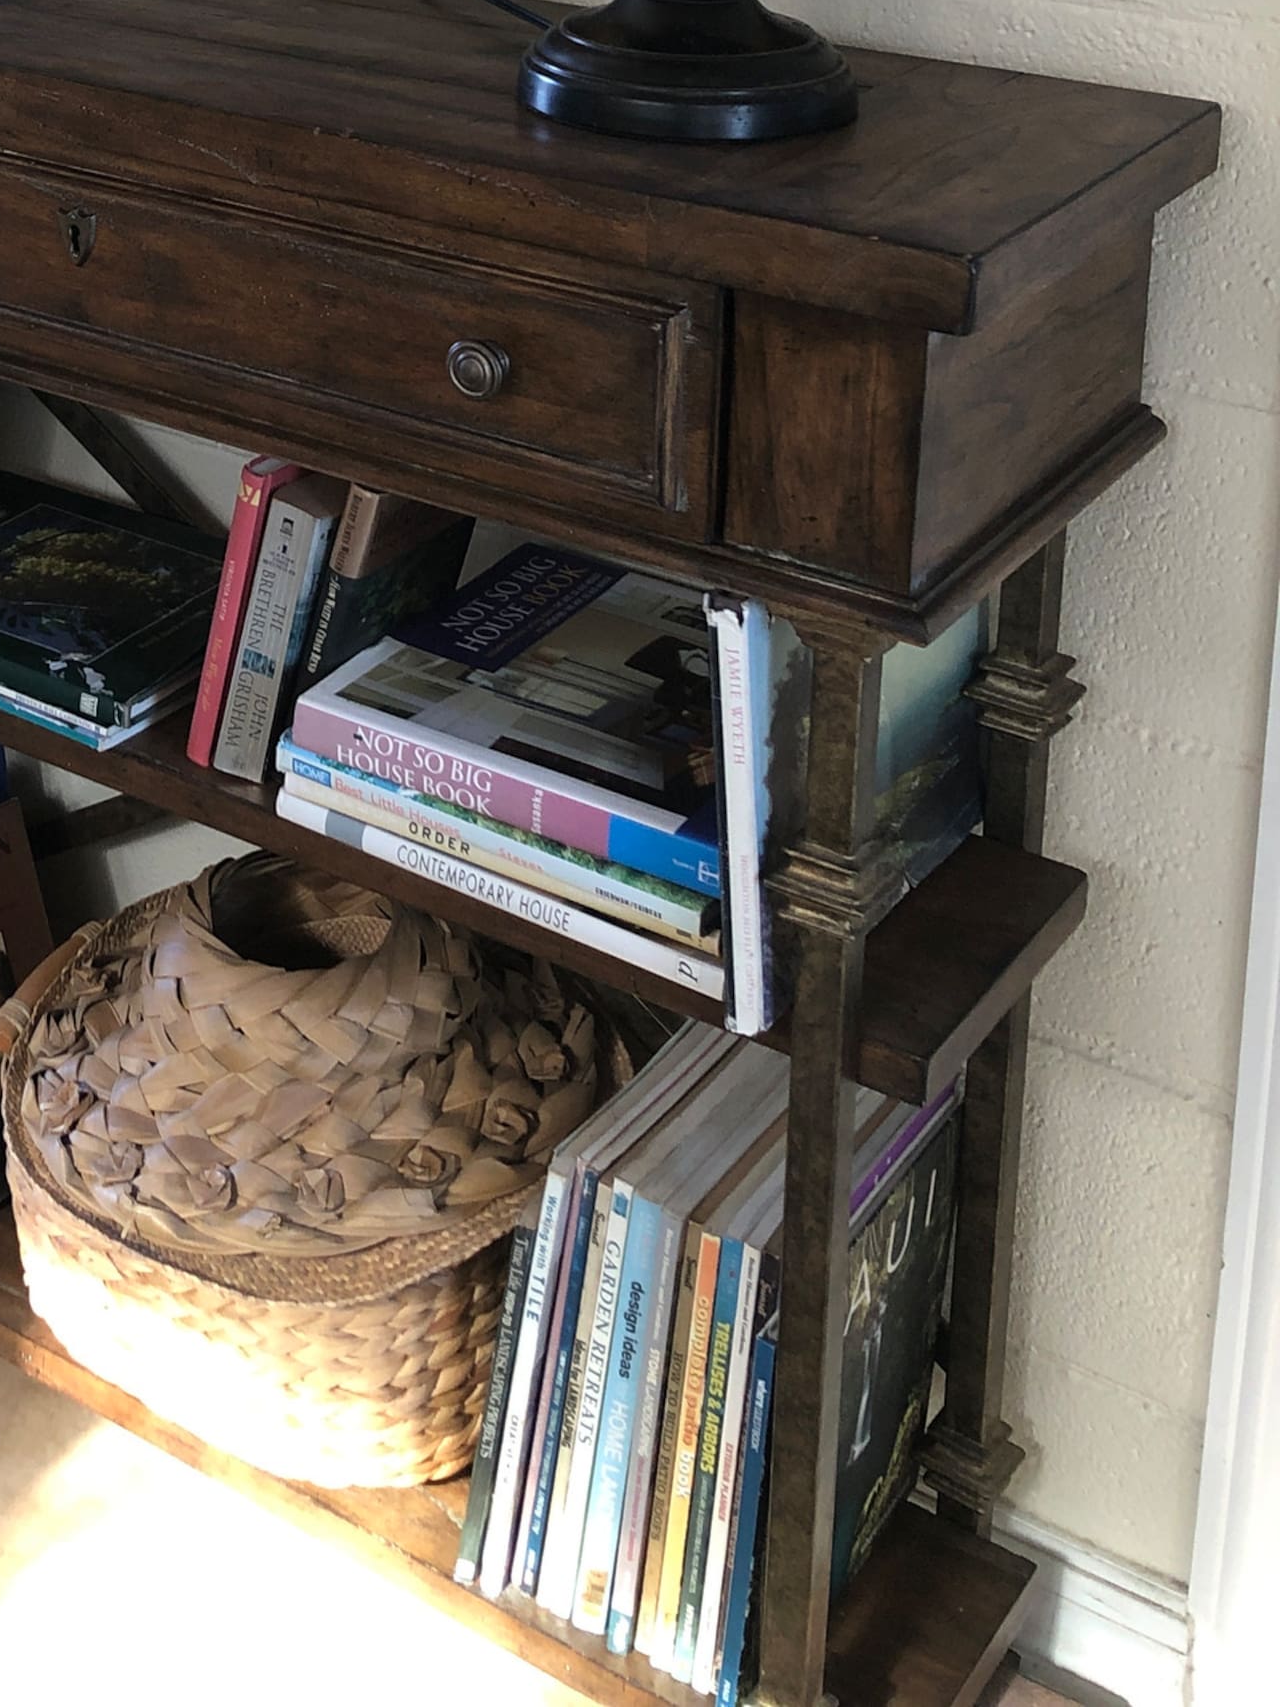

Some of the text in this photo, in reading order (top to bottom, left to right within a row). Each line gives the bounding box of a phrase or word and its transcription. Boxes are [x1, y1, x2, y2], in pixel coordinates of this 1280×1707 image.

[246, 568, 276, 650] BRETHREN
[270, 602, 287, 634] THE
[441, 597, 497, 629] NOT
[485, 581, 521, 602] SO
[512, 556, 557, 583] BIG
[456, 603, 535, 652] HOUSE
[522, 565, 589, 605] BOOK
[225, 671, 255, 747] GRISHAM
[249, 692, 269, 742] JOHN
[724, 648, 745, 766] JAMIE WYETH
[293, 760, 331, 785] HOME
[336, 745, 493, 817] HOUSE BOOK
[355, 725, 493, 792] NOT SO BIG
[334, 777, 364, 801] Best
[370, 795, 405, 816] Little
[408, 821, 471, 855] ORDER
[396, 844, 570, 932] CONTEMPORARY HOUSE
[524, 1194, 558, 1321] Working with TILE
[589, 1210, 605, 1246] Sunset
[843, 1168, 937, 1337] AUI
[506, 1267, 524, 1291] Life
[682, 1256, 698, 1290] Sunset
[753, 1279, 772, 1317] Sunset
[487, 1327, 514, 1405] LANDSCAPING
[573, 1239, 623, 1444] GARDEN RETREATS
[617, 1280, 647, 1379] design ideas
[644, 1347, 661, 1384] STONE
[558, 1338, 586, 1447] Ideas for LANDSCAPING
[674, 1294, 715, 1499] complete patio book
[698, 1320, 731, 1474] TRELLISES & ARBORS
[477, 1405, 500, 1458] PROJECTS
[602, 1399, 630, 1461] HOME
[649, 1350, 683, 1540] HOW TO BUILD PATIO ROOFS
